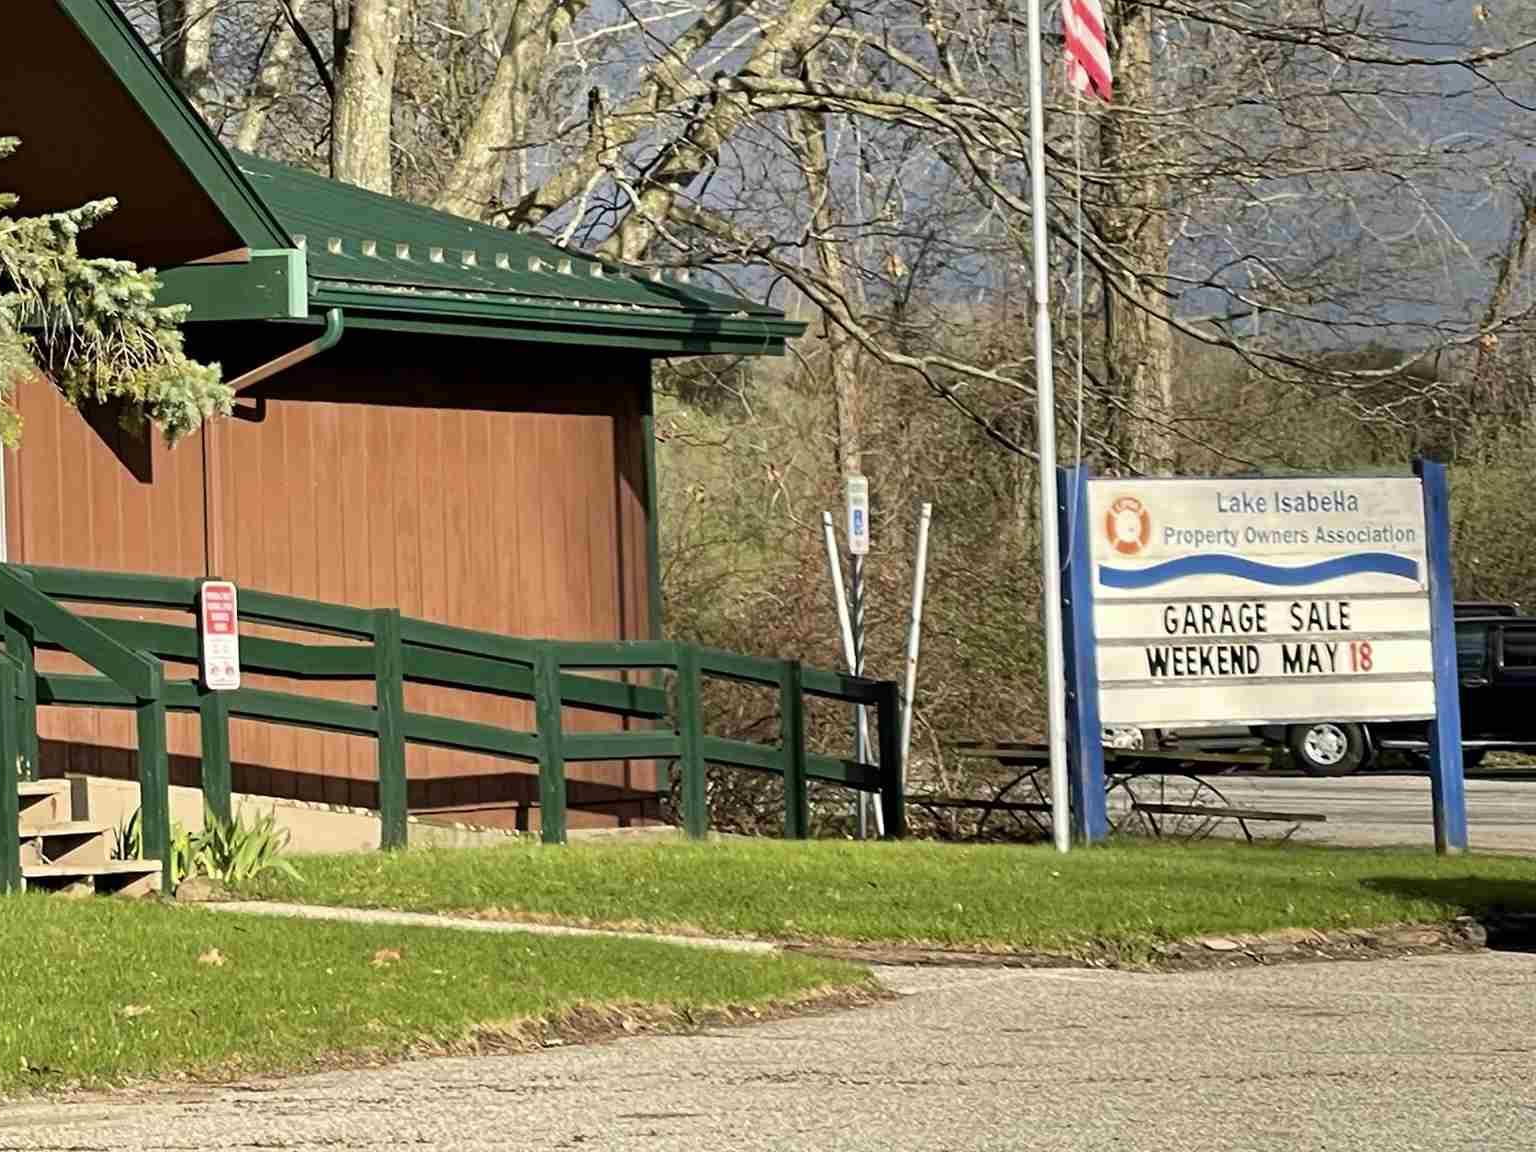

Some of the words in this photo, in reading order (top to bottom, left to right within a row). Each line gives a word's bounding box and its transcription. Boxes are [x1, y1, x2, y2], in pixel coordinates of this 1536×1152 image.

[1216, 491, 1268, 513] Lake
[1275, 490, 1359, 513] Isabella
[1163, 526, 1238, 547] Property
[1245, 525, 1310, 544] Owners
[1314, 523, 1417, 543] Association
[1163, 603, 1268, 635] GARAGE
[1290, 601, 1351, 632] SALE
[1146, 644, 1261, 677] WEEKEND
[1281, 643, 1339, 674] MAY
[1348, 639, 1374, 673] 18
